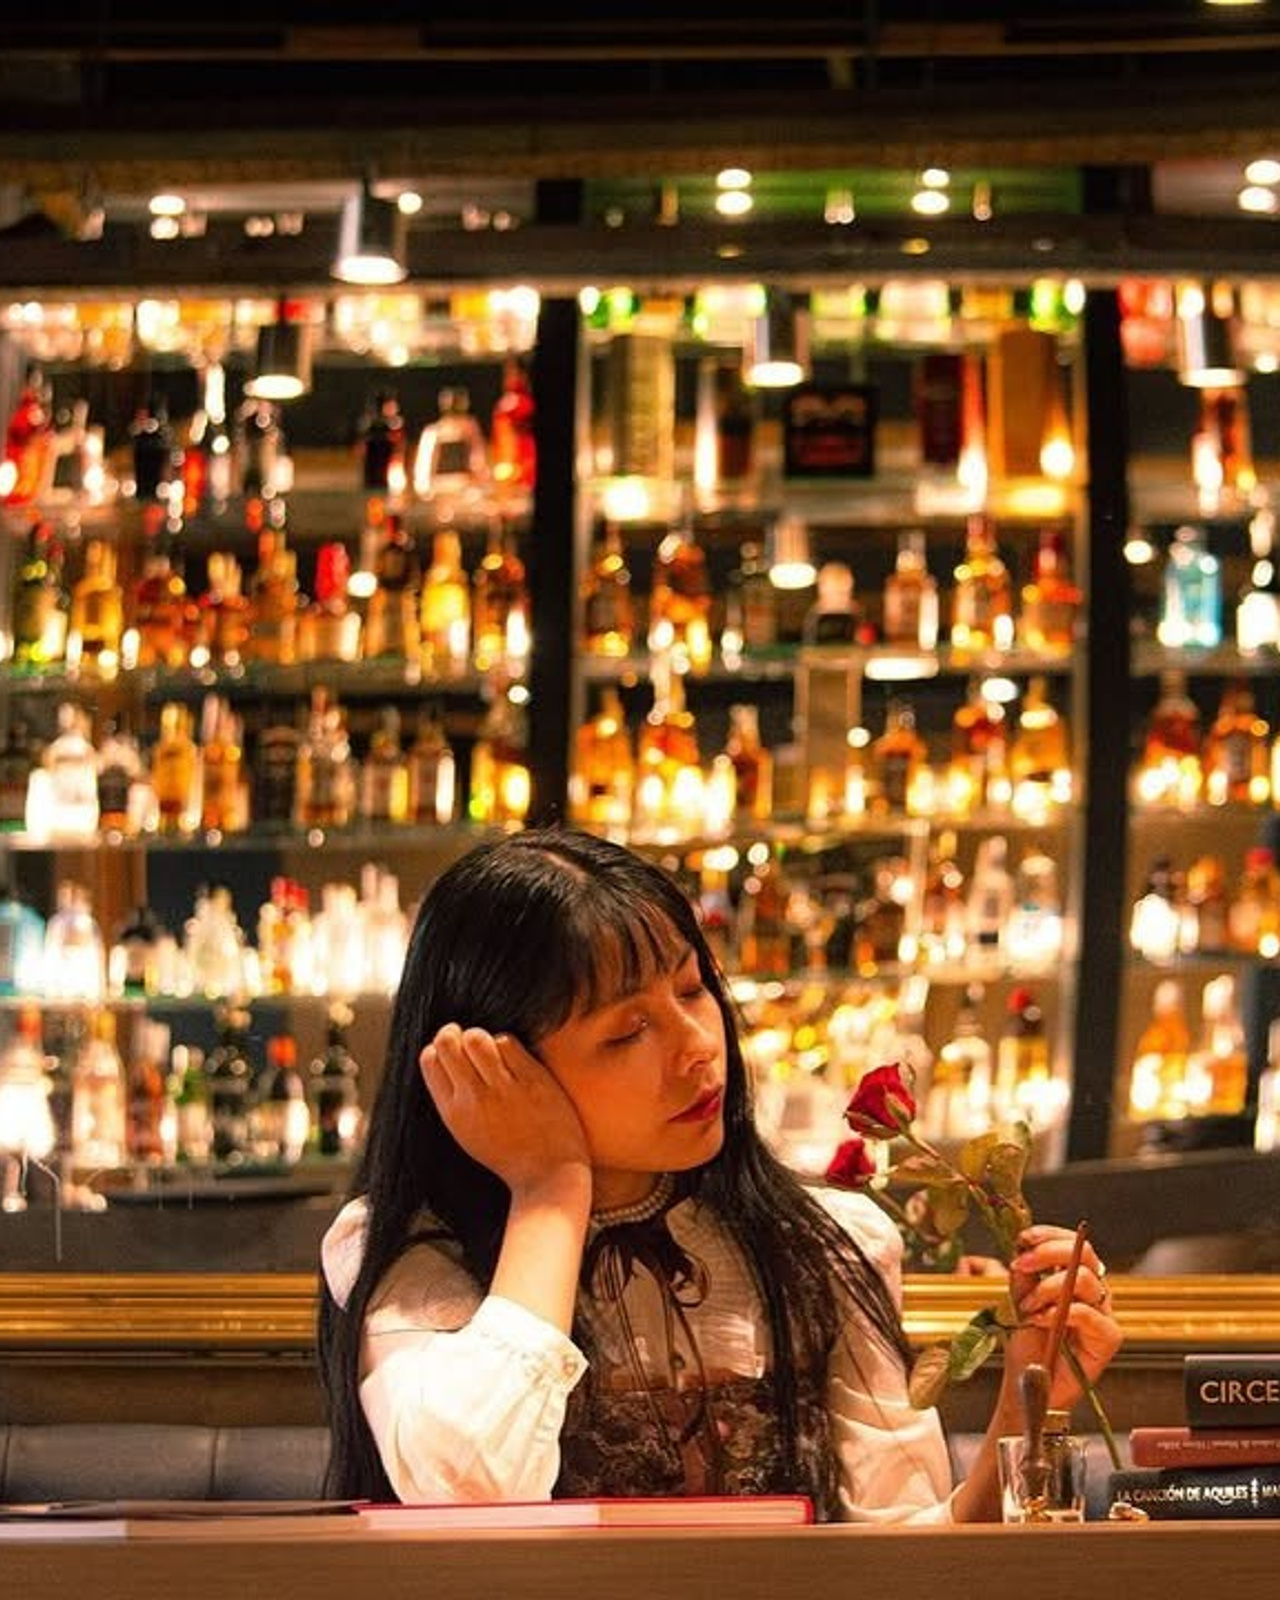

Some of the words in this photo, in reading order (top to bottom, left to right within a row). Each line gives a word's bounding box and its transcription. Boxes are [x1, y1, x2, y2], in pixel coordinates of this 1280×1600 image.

[1200, 1380, 1280, 1403] CIRCE
[1133, 1484, 1184, 1502] CANCIÓN
[1186, 1487, 1201, 1501] DE
[1203, 1485, 1248, 1506] AQUILES
[1262, 1484, 1280, 1498] MA
